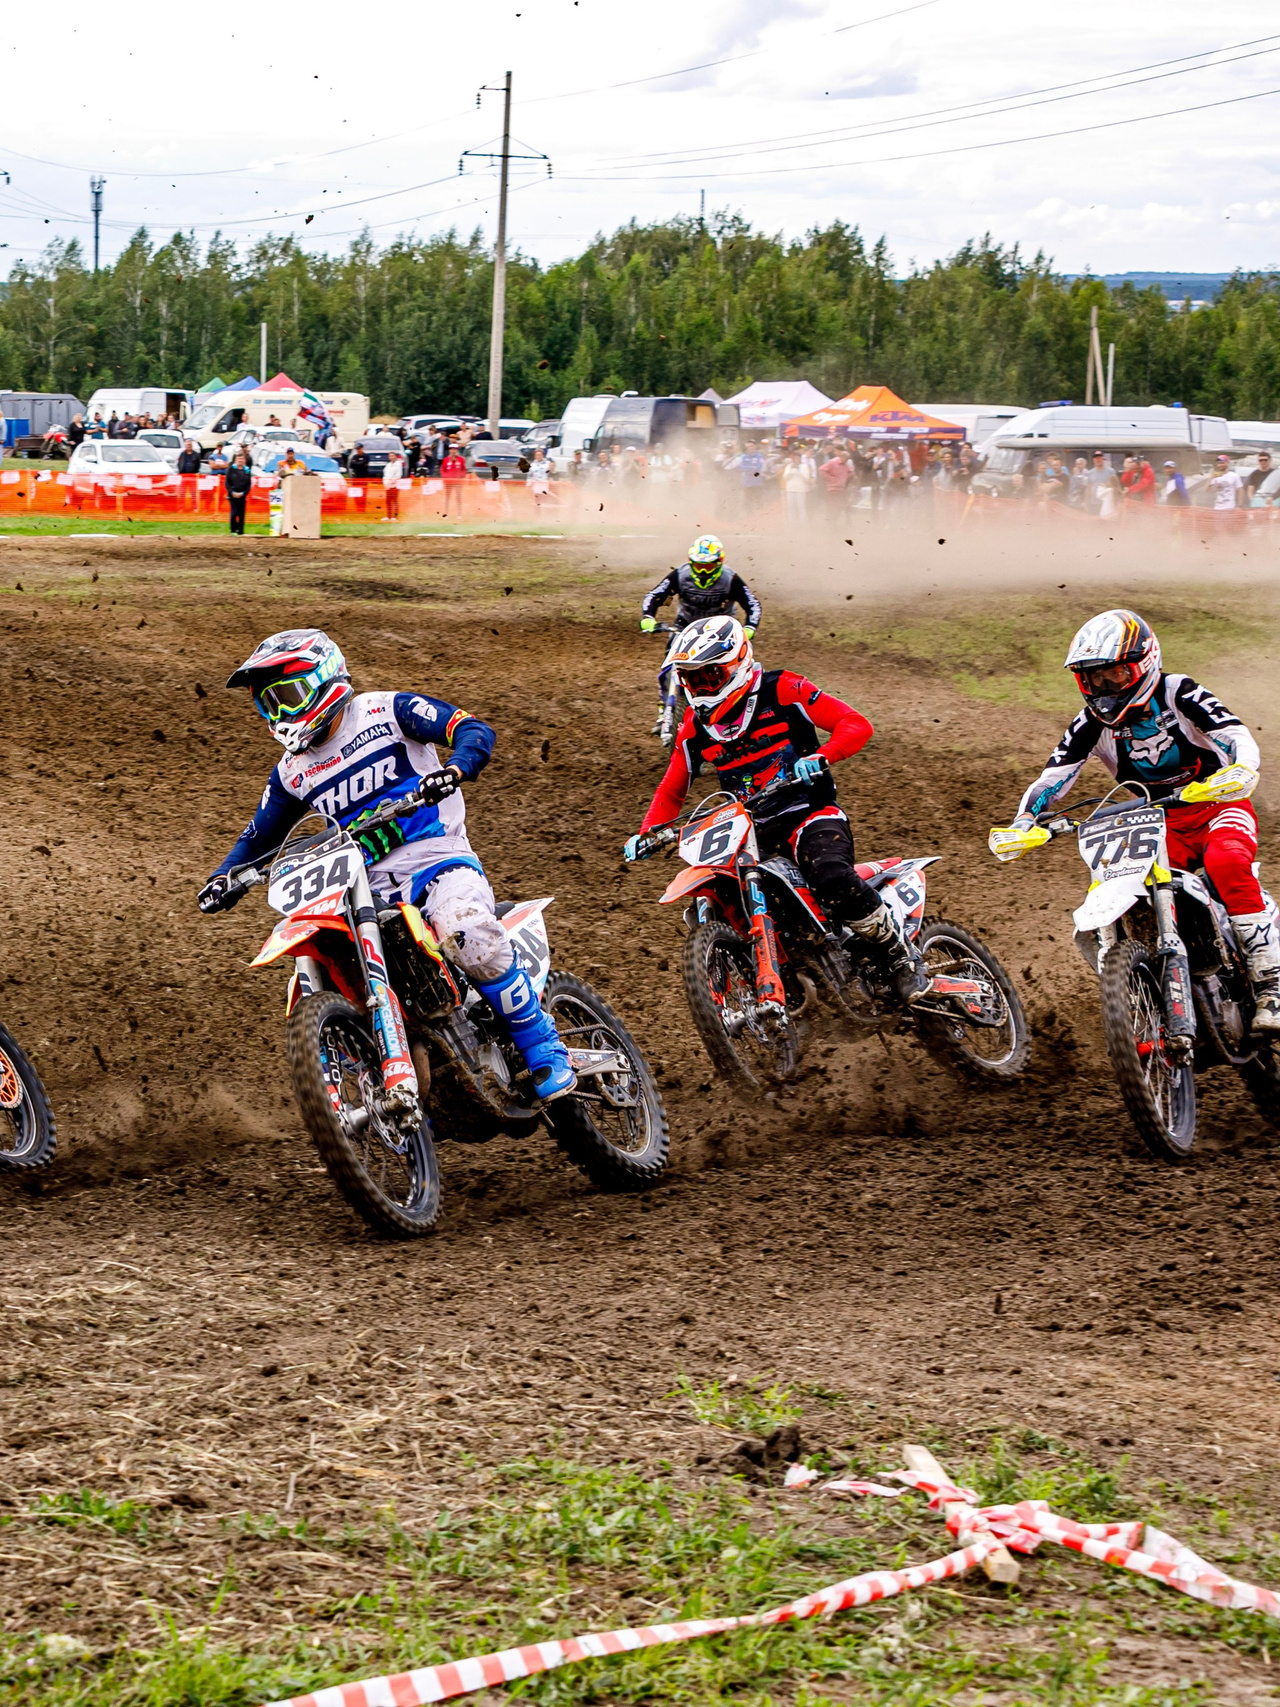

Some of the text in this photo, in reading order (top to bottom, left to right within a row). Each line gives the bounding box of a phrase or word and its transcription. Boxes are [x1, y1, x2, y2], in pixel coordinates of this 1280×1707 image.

[868, 410, 926, 423] KTM
[351, 724, 391, 750] YAMAHA
[305, 756, 342, 778] ESCONDIDO
[312, 756, 399, 817] THOR
[698, 820, 734, 862] 6
[1086, 826, 1160, 870] 776
[282, 854, 351, 913] 334
[895, 882, 920, 907] 6
[509, 926, 549, 978] 34
[380, 1001, 402, 1058] MOTOREX
[383, 1061, 416, 1081] KTM
